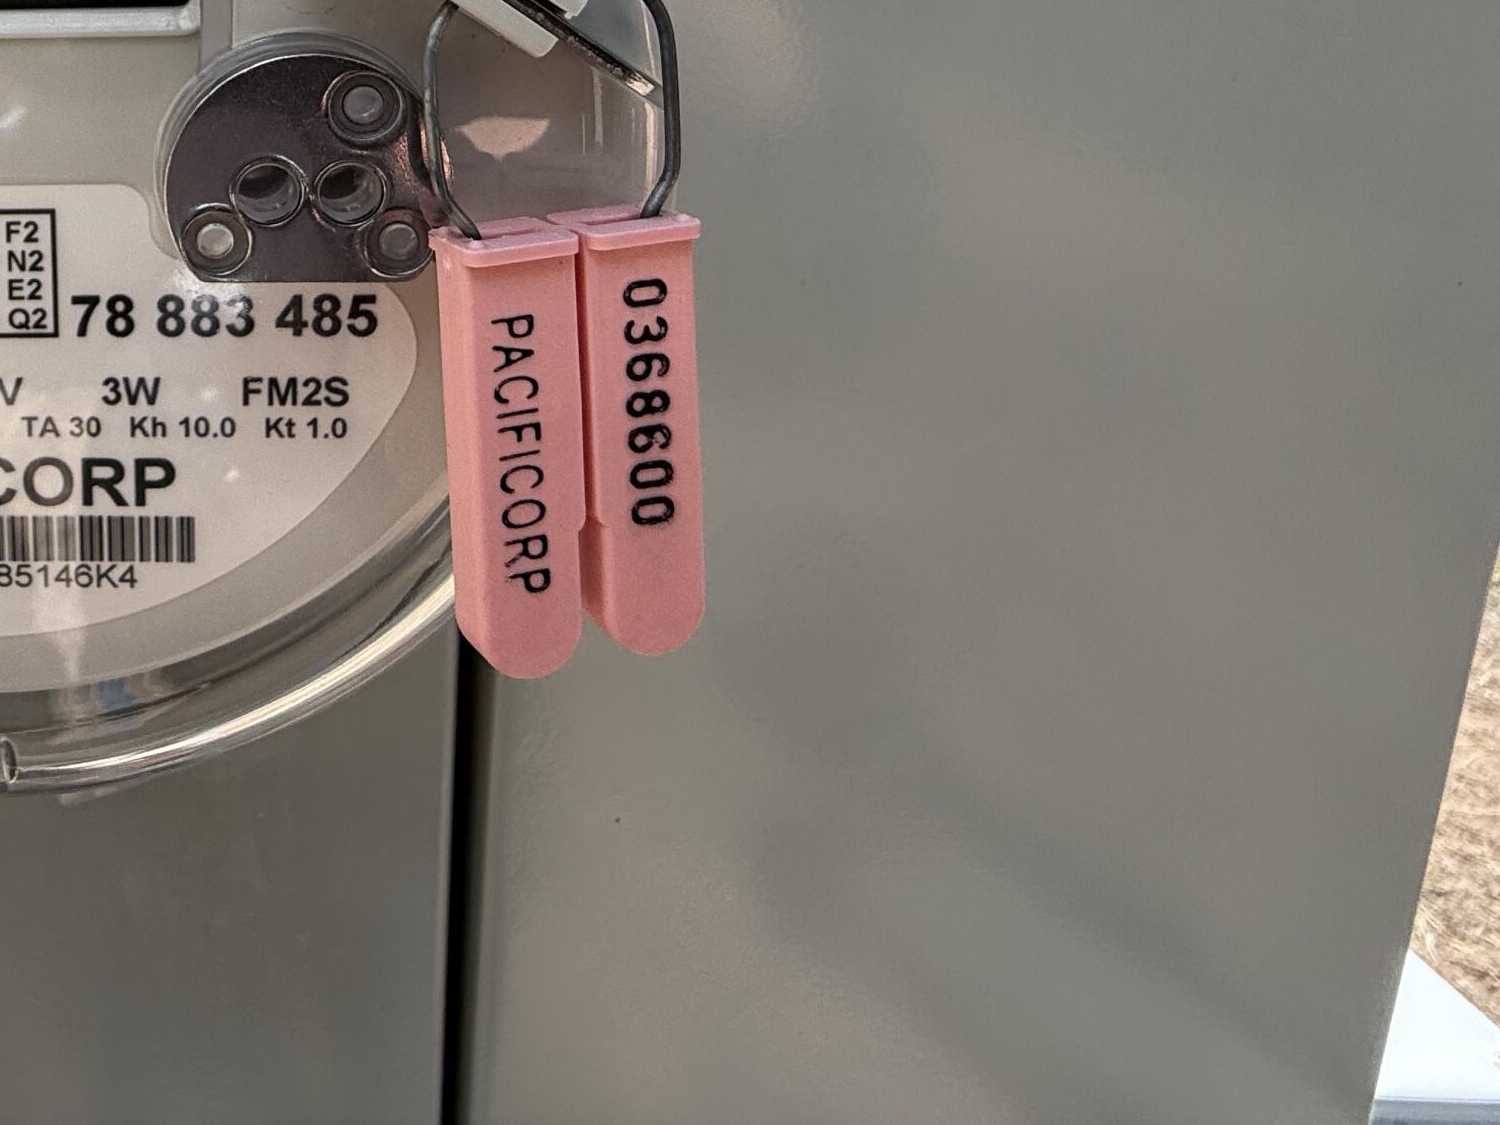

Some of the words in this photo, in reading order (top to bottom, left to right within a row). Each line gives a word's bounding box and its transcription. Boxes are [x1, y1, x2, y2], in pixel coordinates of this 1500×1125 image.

[5, 220, 40, 243] F2
[7, 249, 45, 272] N2
[8, 278, 43, 301] E2
[8, 307, 48, 330] Q2
[71, 293, 135, 338] 78
[156, 293, 256, 338] 883
[274, 293, 378, 338] 485
[101, 376, 161, 406] 3W
[241, 376, 350, 407] FM2S
[622, 277, 676, 527] 0368600
[20, 415, 61, 438] TA
[68, 415, 102, 438] 30
[129, 416, 167, 438] Kh
[178, 416, 237, 438] 10.0
[264, 417, 296, 439] Kt
[306, 416, 348, 439] 1.0
[490, 313, 552, 595] PACIFICORP
